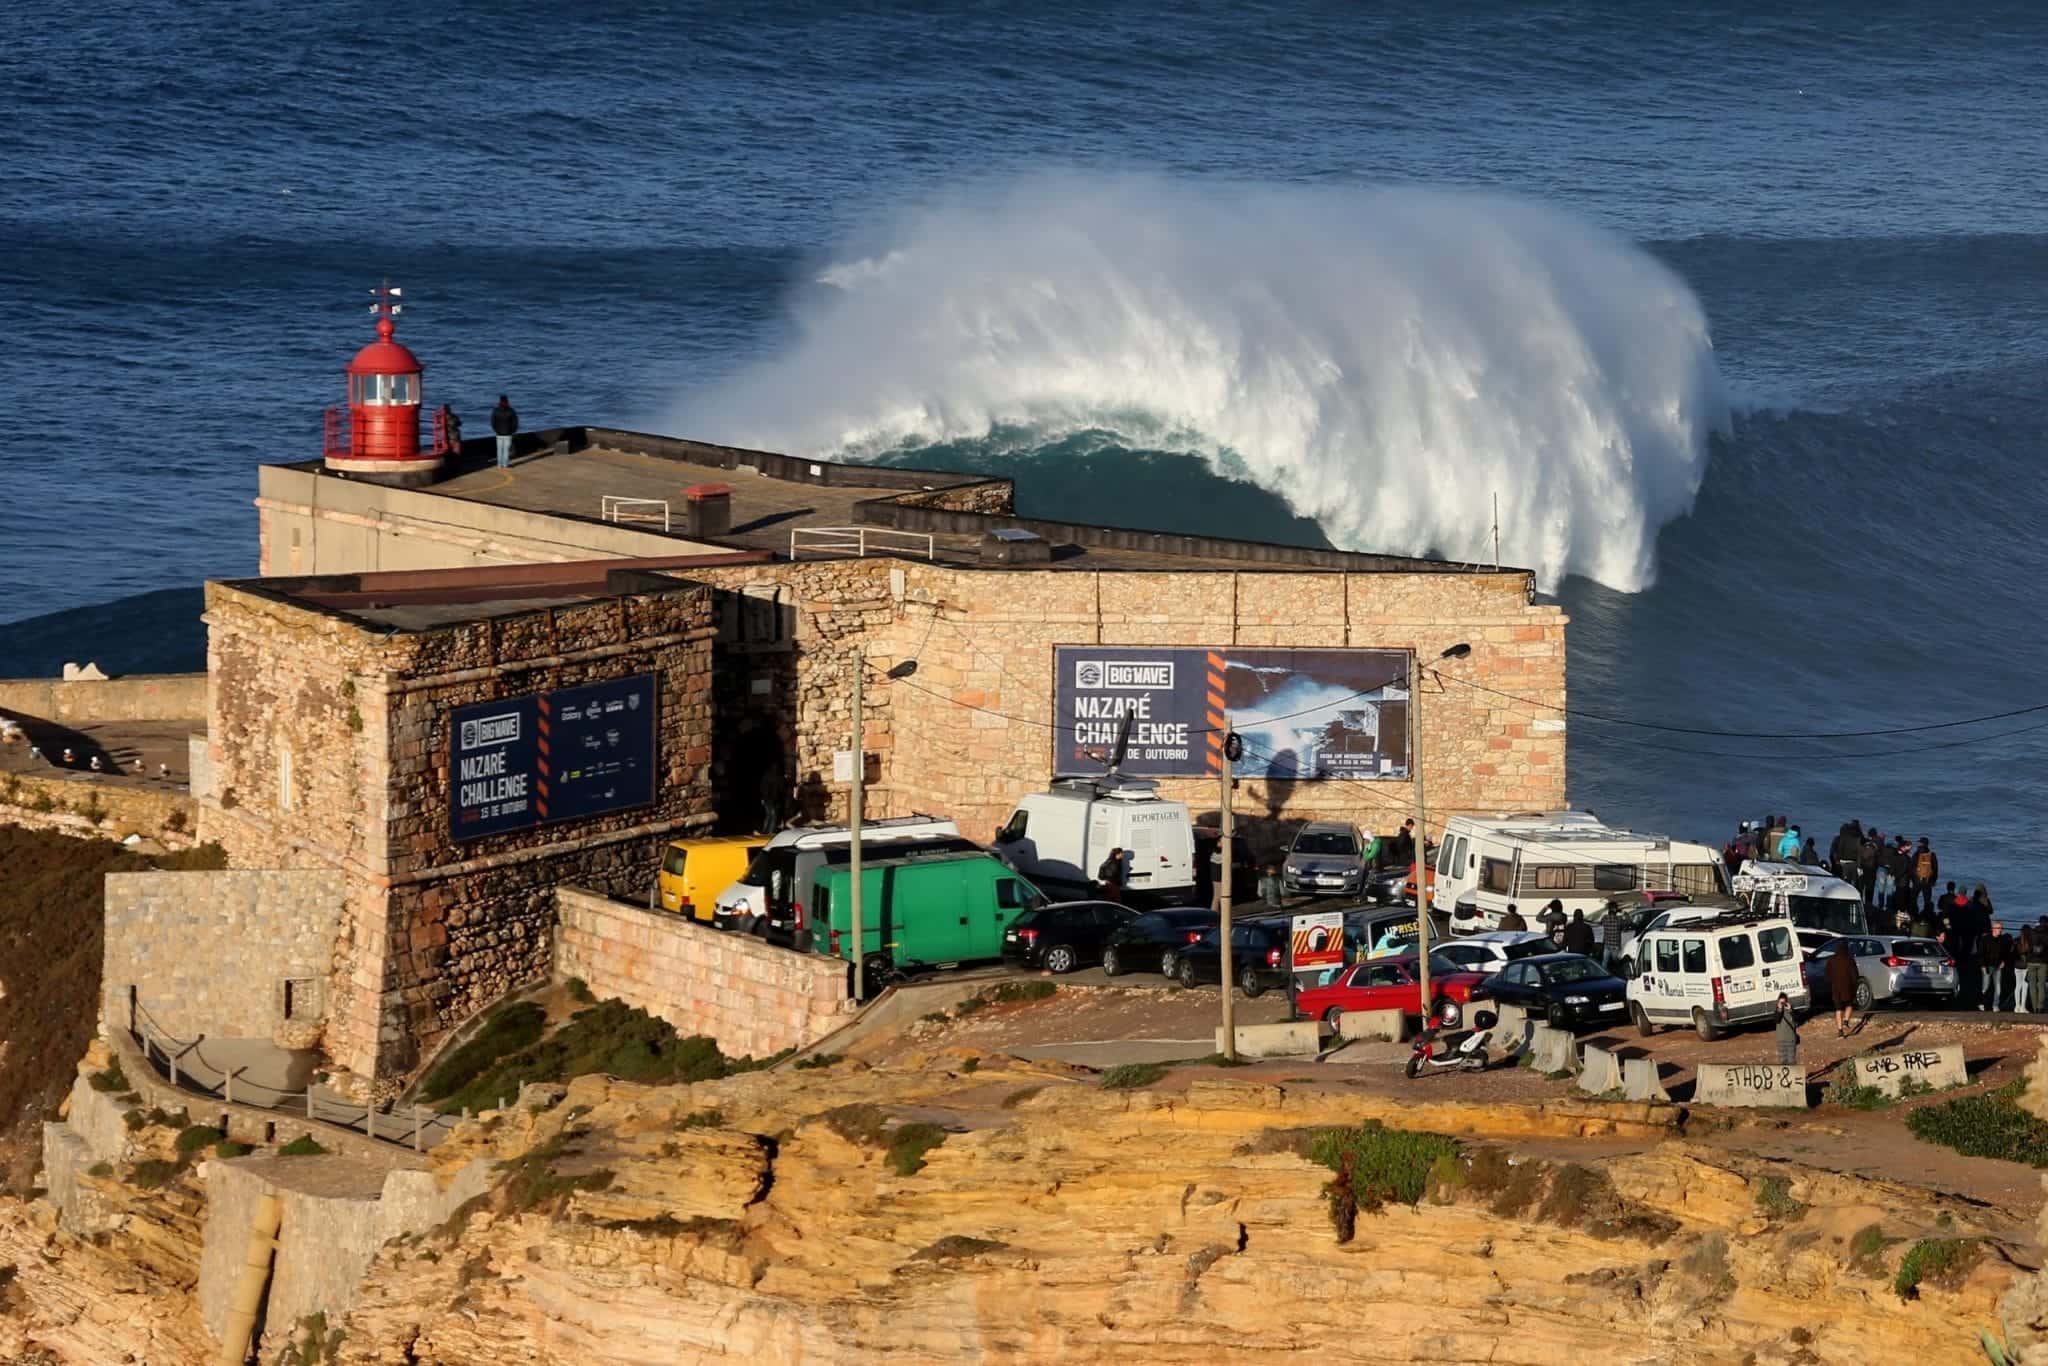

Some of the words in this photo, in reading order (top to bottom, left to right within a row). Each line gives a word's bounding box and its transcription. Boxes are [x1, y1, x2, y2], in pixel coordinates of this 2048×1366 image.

[1075, 692, 1151, 719] NAZARÉ
[461, 746, 507, 781] NAZARÉ
[1127, 748, 1140, 760] DE
[1145, 748, 1189, 761] OUTUBRO
[461, 773, 528, 808] CHALLENGE
[480, 806, 489, 819] 15
[491, 804, 500, 817] DE
[1131, 811, 1180, 823] REPORTAGEM
